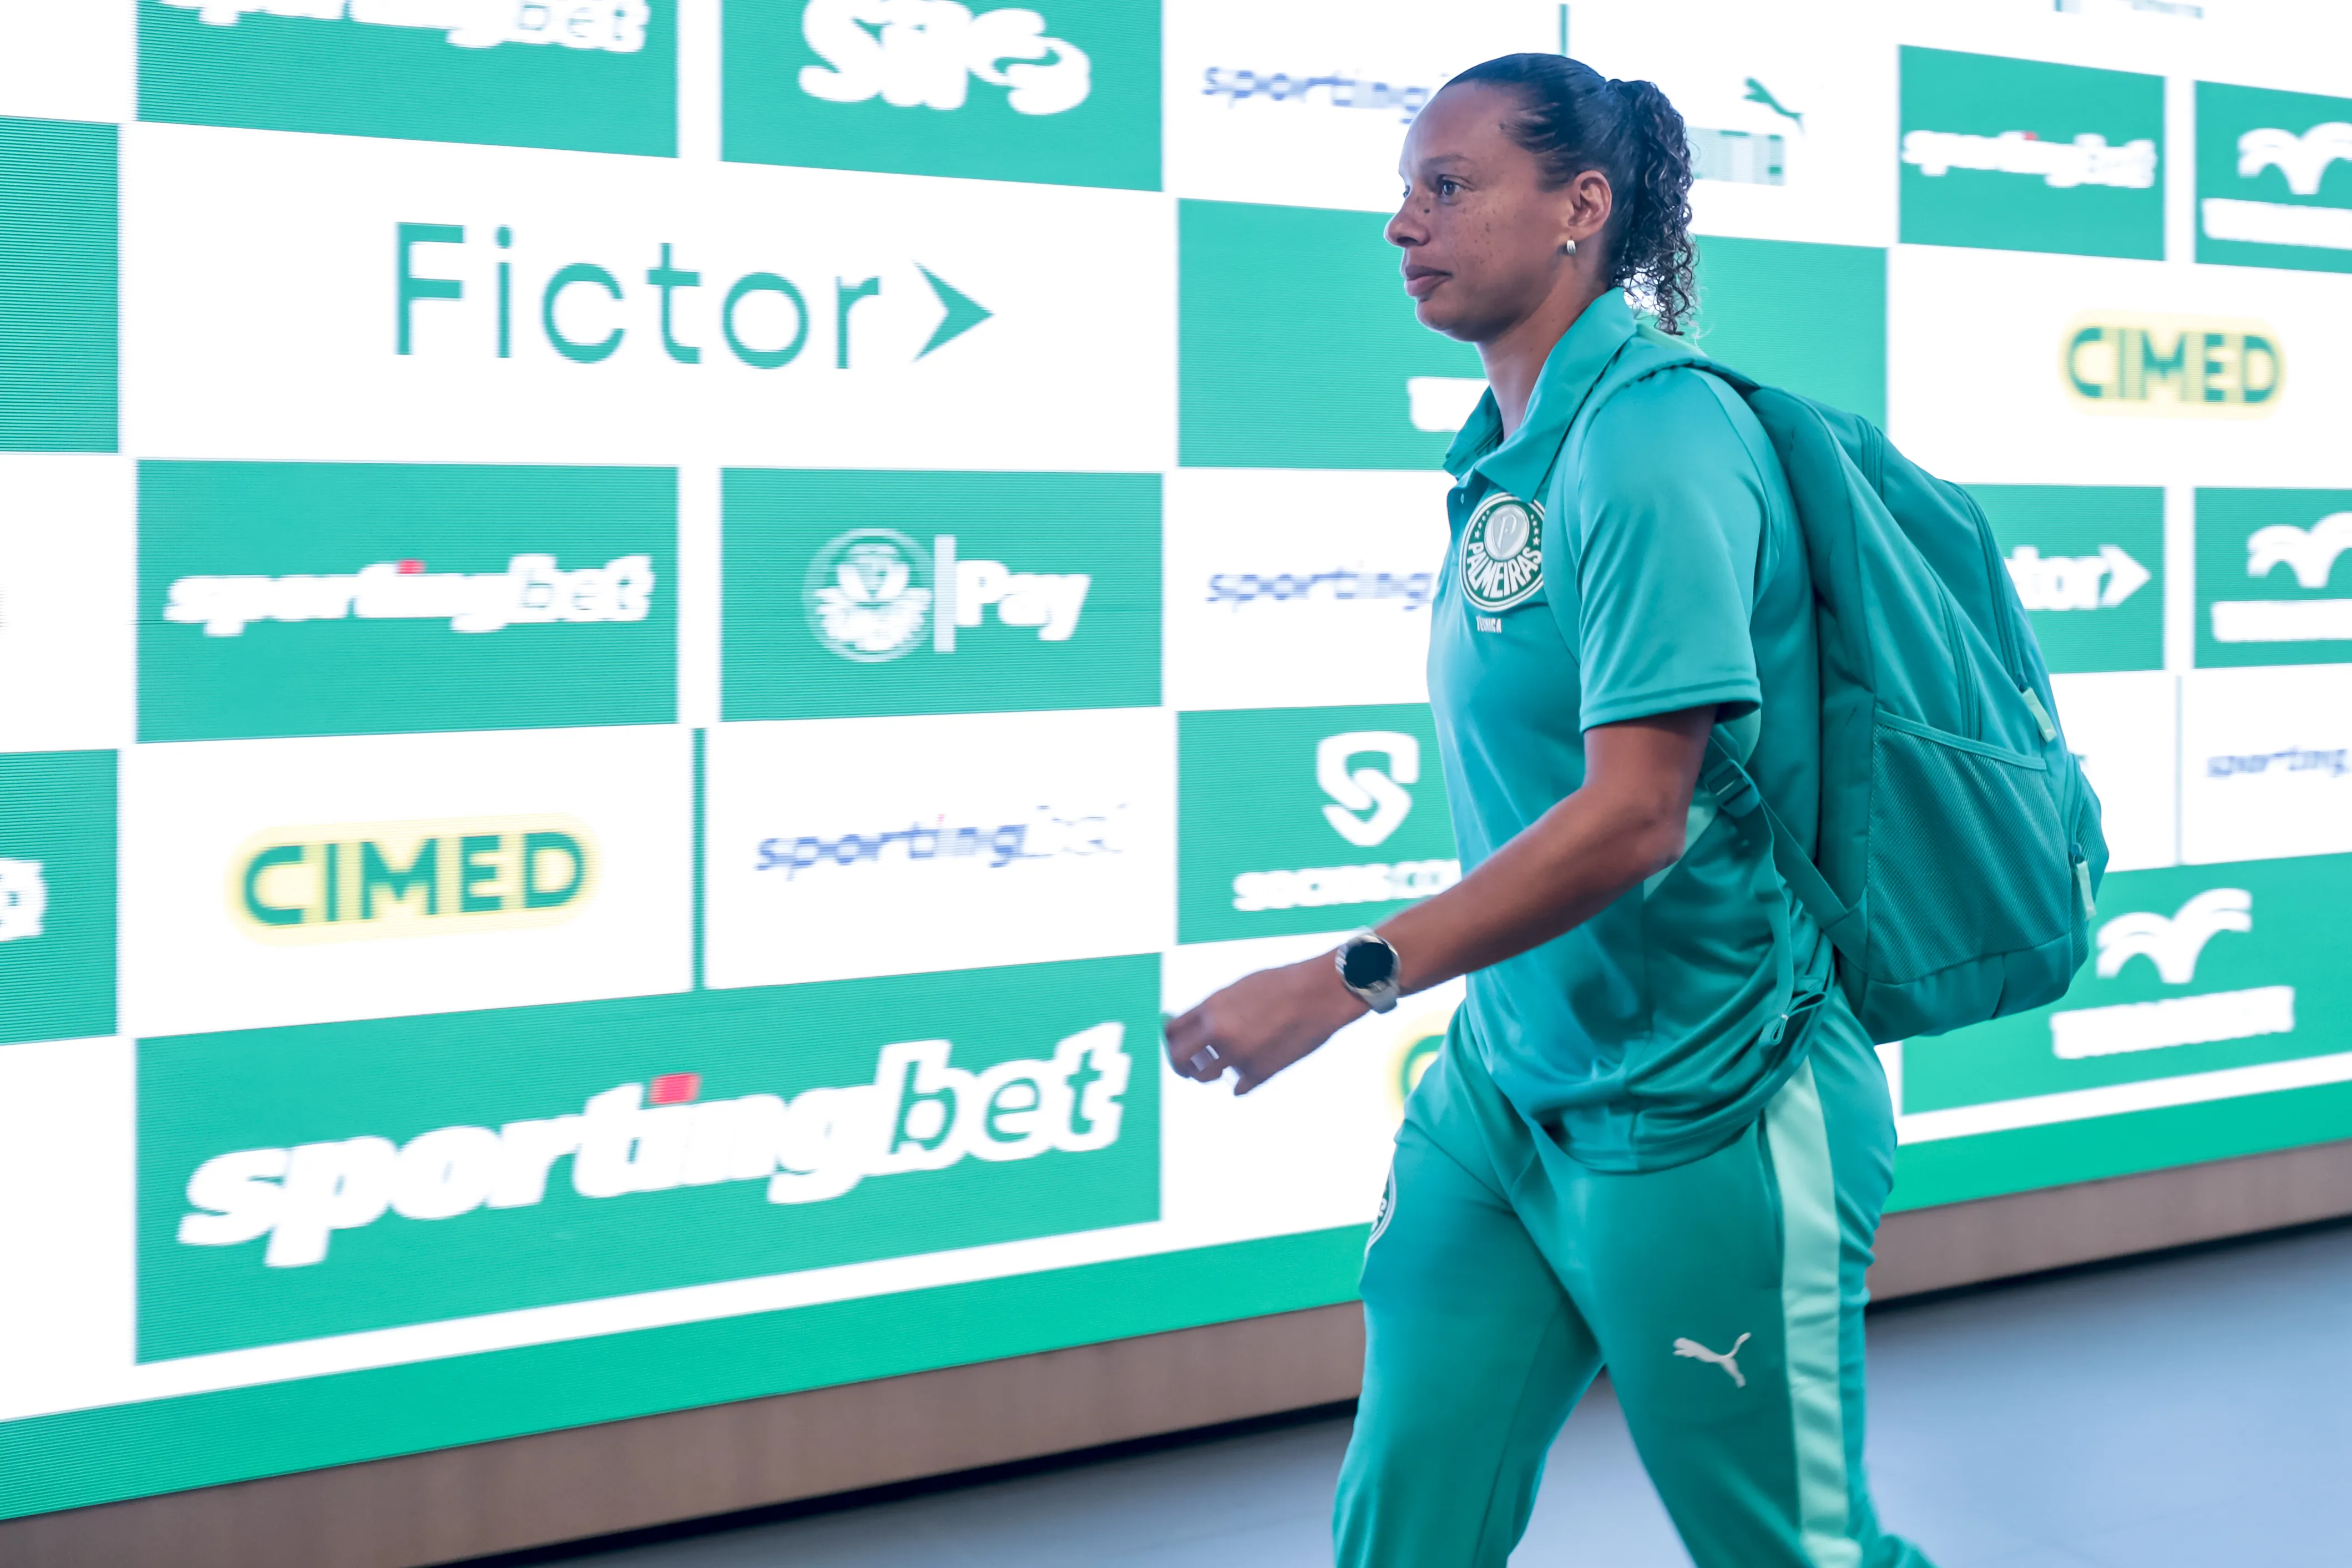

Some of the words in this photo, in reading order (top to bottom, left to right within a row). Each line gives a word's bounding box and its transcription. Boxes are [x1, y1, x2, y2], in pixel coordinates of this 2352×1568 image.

[1201, 66, 1433, 124] sporting
[394, 221, 883, 370] Fictor
[2066, 326, 2283, 404] CIMED
[955, 559, 1092, 641] Pay
[1204, 559, 1434, 612] sporting
[1466, 541, 1542, 599] PALMEIRAS
[241, 831, 586, 927] CIMED
[175, 1021, 1132, 1268] sportingbet
